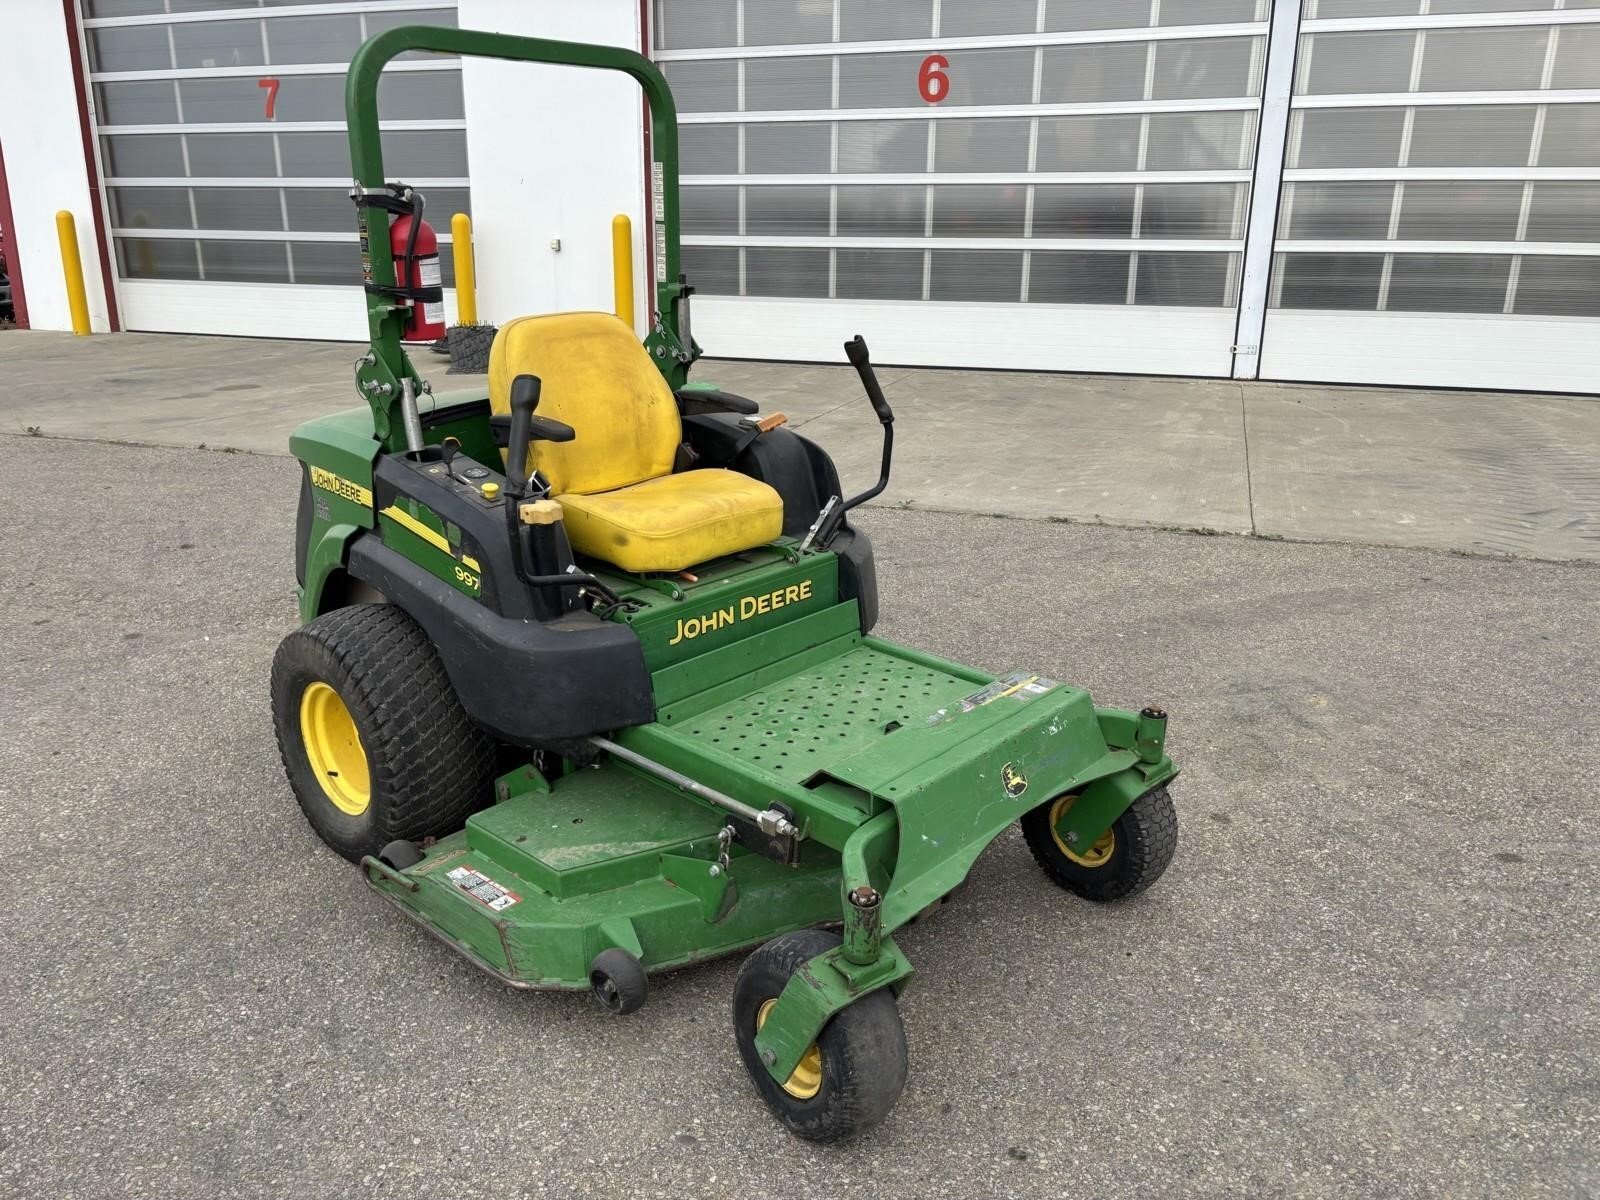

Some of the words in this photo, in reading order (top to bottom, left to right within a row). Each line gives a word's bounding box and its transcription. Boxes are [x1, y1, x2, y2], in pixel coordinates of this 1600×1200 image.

[918, 54, 950, 103] 6
[258, 79, 280, 119] 7
[314, 469, 334, 492] JOHN
[334, 476, 362, 503] DEERE
[455, 566, 479, 590] 997
[669, 606, 735, 646] JOHN
[740, 579, 812, 620] DEERE
